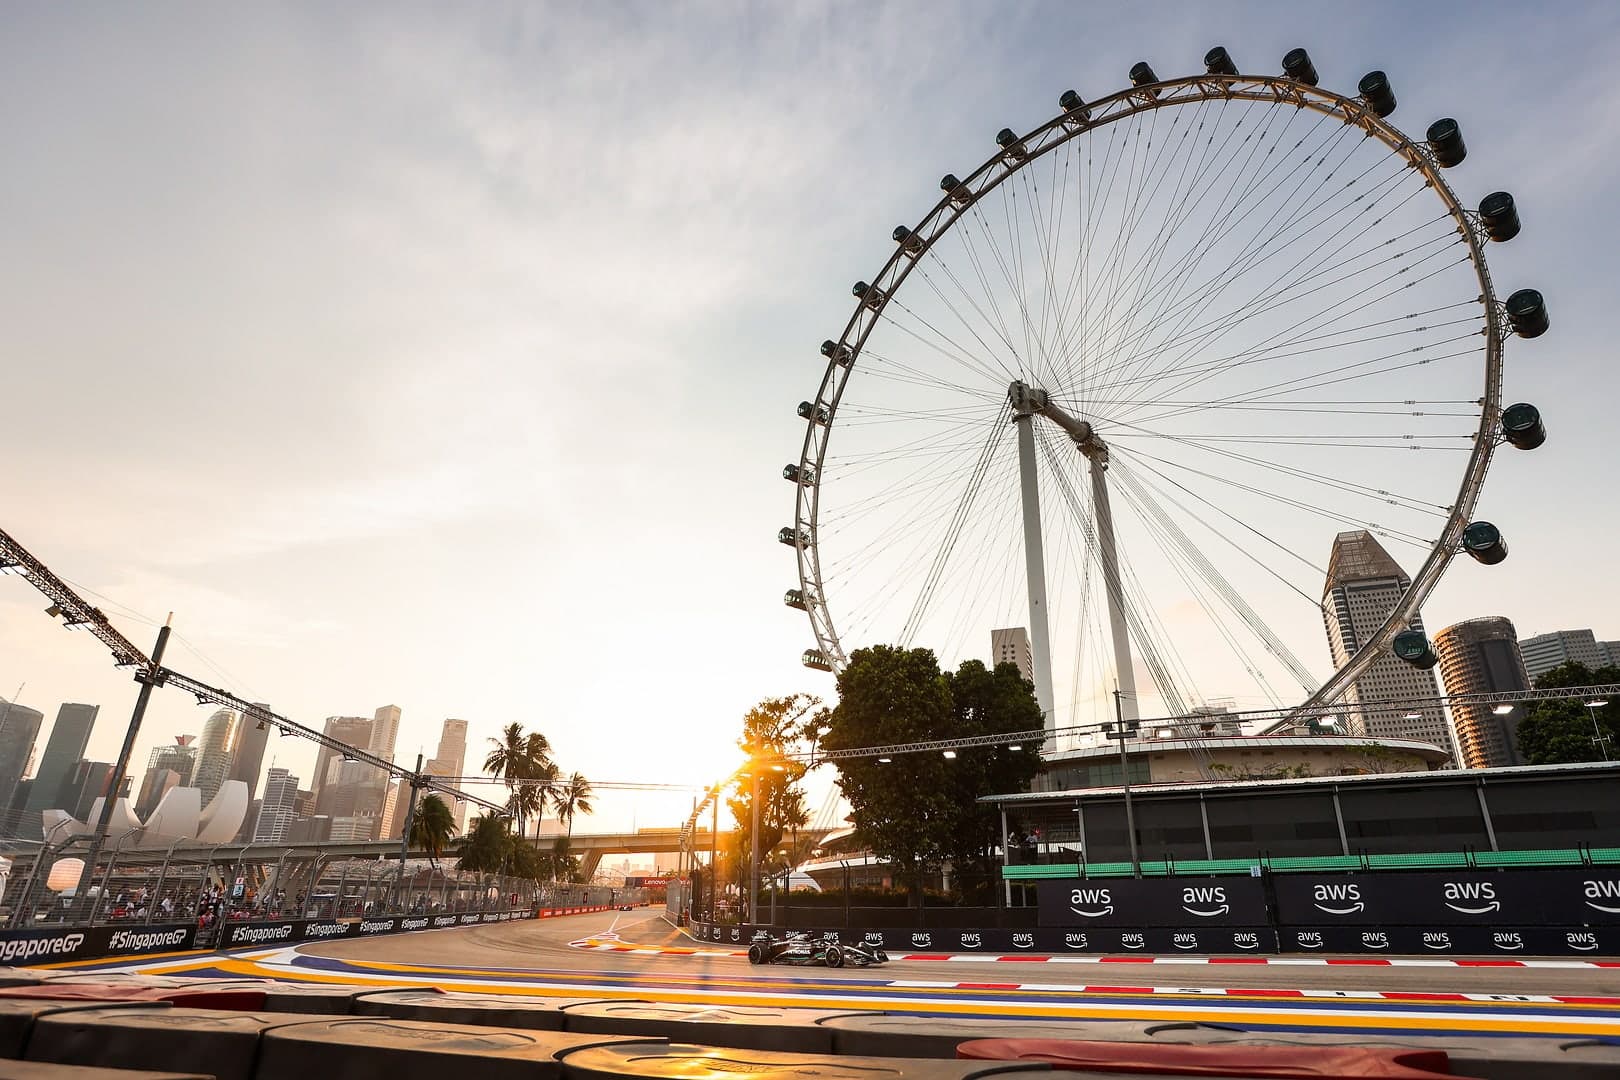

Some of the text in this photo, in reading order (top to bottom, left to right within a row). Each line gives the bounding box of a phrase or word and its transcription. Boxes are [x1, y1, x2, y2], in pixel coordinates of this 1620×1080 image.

[1183, 887, 1226, 903] aws
[1314, 884, 1360, 900] aws
[1444, 882, 1495, 899] aws
[1072, 889, 1111, 904] aws
[305, 922, 350, 936] #SingaporeGP
[360, 920, 394, 933] #SingaporeGP
[232, 925, 292, 943] #SingaporeGP
[823, 932, 838, 940] aws
[865, 933, 882, 941] aws
[912, 933, 930, 941] aws
[961, 933, 980, 942] aws
[1013, 933, 1032, 942] aws
[1066, 933, 1086, 942] aws
[1122, 933, 1143, 942] aws
[1174, 933, 1196, 942] aws
[1234, 933, 1257, 942] aws
[1297, 932, 1321, 941] aws
[1362, 932, 1386, 942] aws
[1423, 933, 1449, 942] aws
[1494, 932, 1520, 943] aws
[1567, 932, 1596, 943] aws
[109, 929, 187, 950] #SingaporeGP
